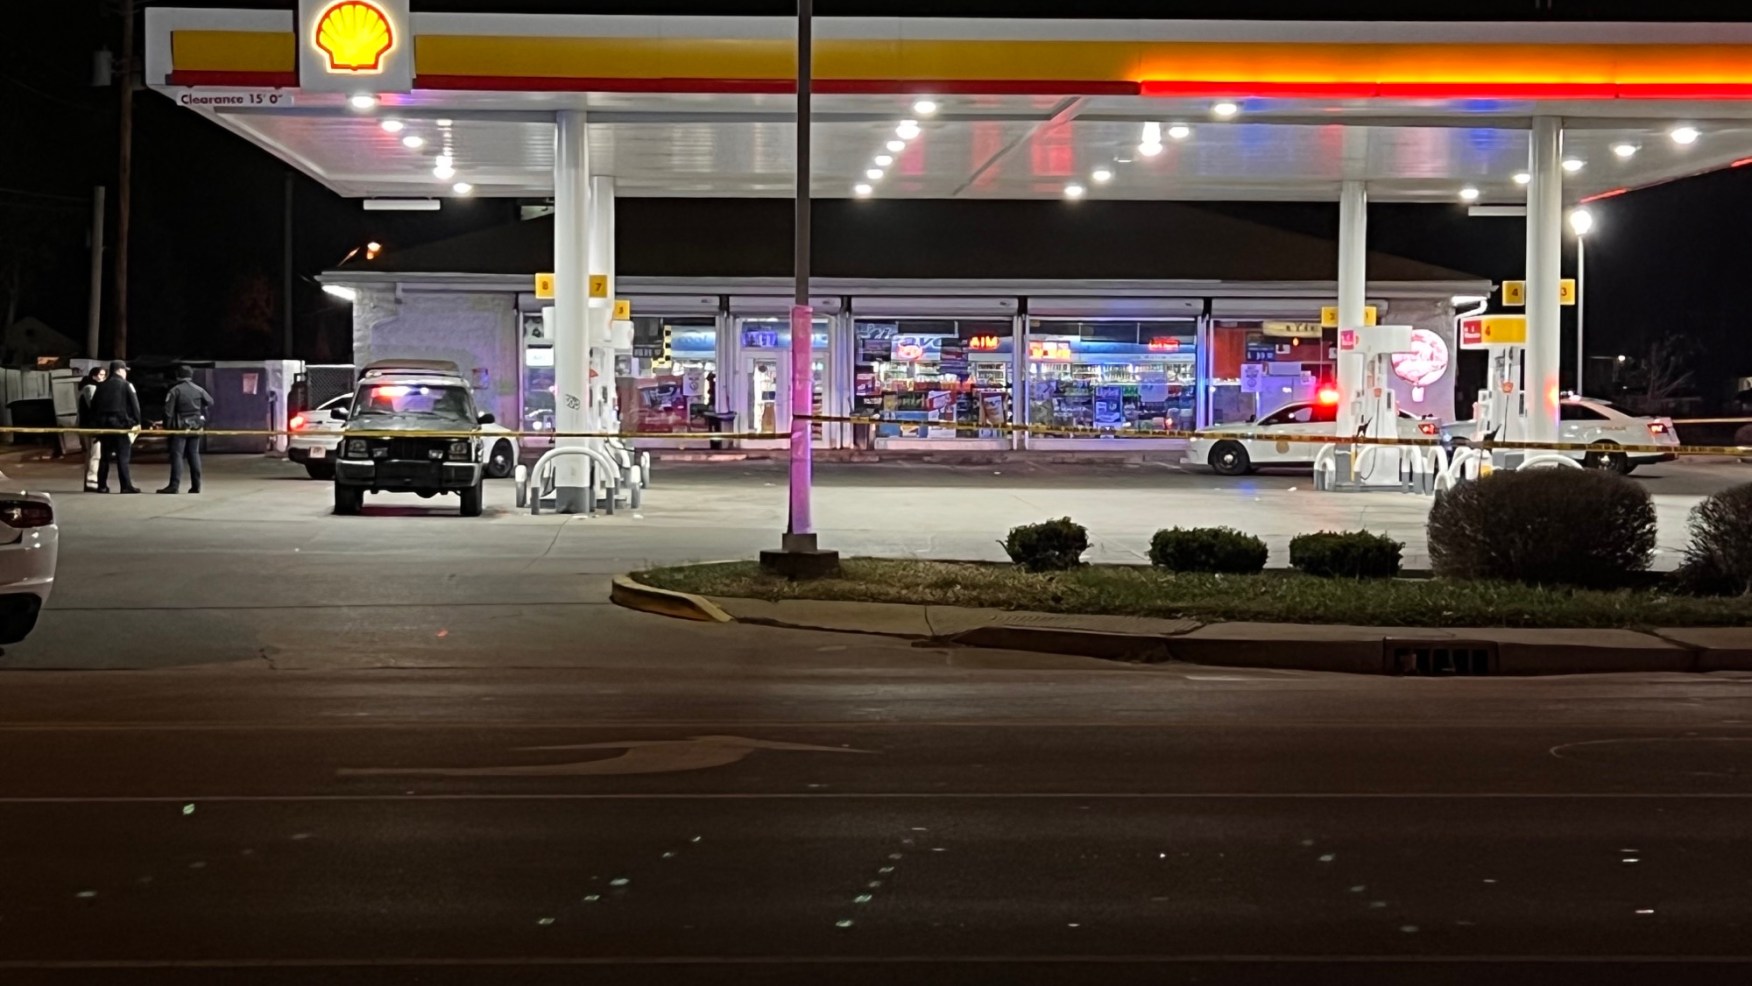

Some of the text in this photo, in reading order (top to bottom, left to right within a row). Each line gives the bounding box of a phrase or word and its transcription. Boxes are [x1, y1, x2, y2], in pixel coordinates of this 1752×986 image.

[181, 93, 243, 105] Clearance
[542, 281, 549, 290] 8
[595, 283, 602, 292] 7
[1511, 288, 1518, 297] 4
[1485, 326, 1491, 336] 4
